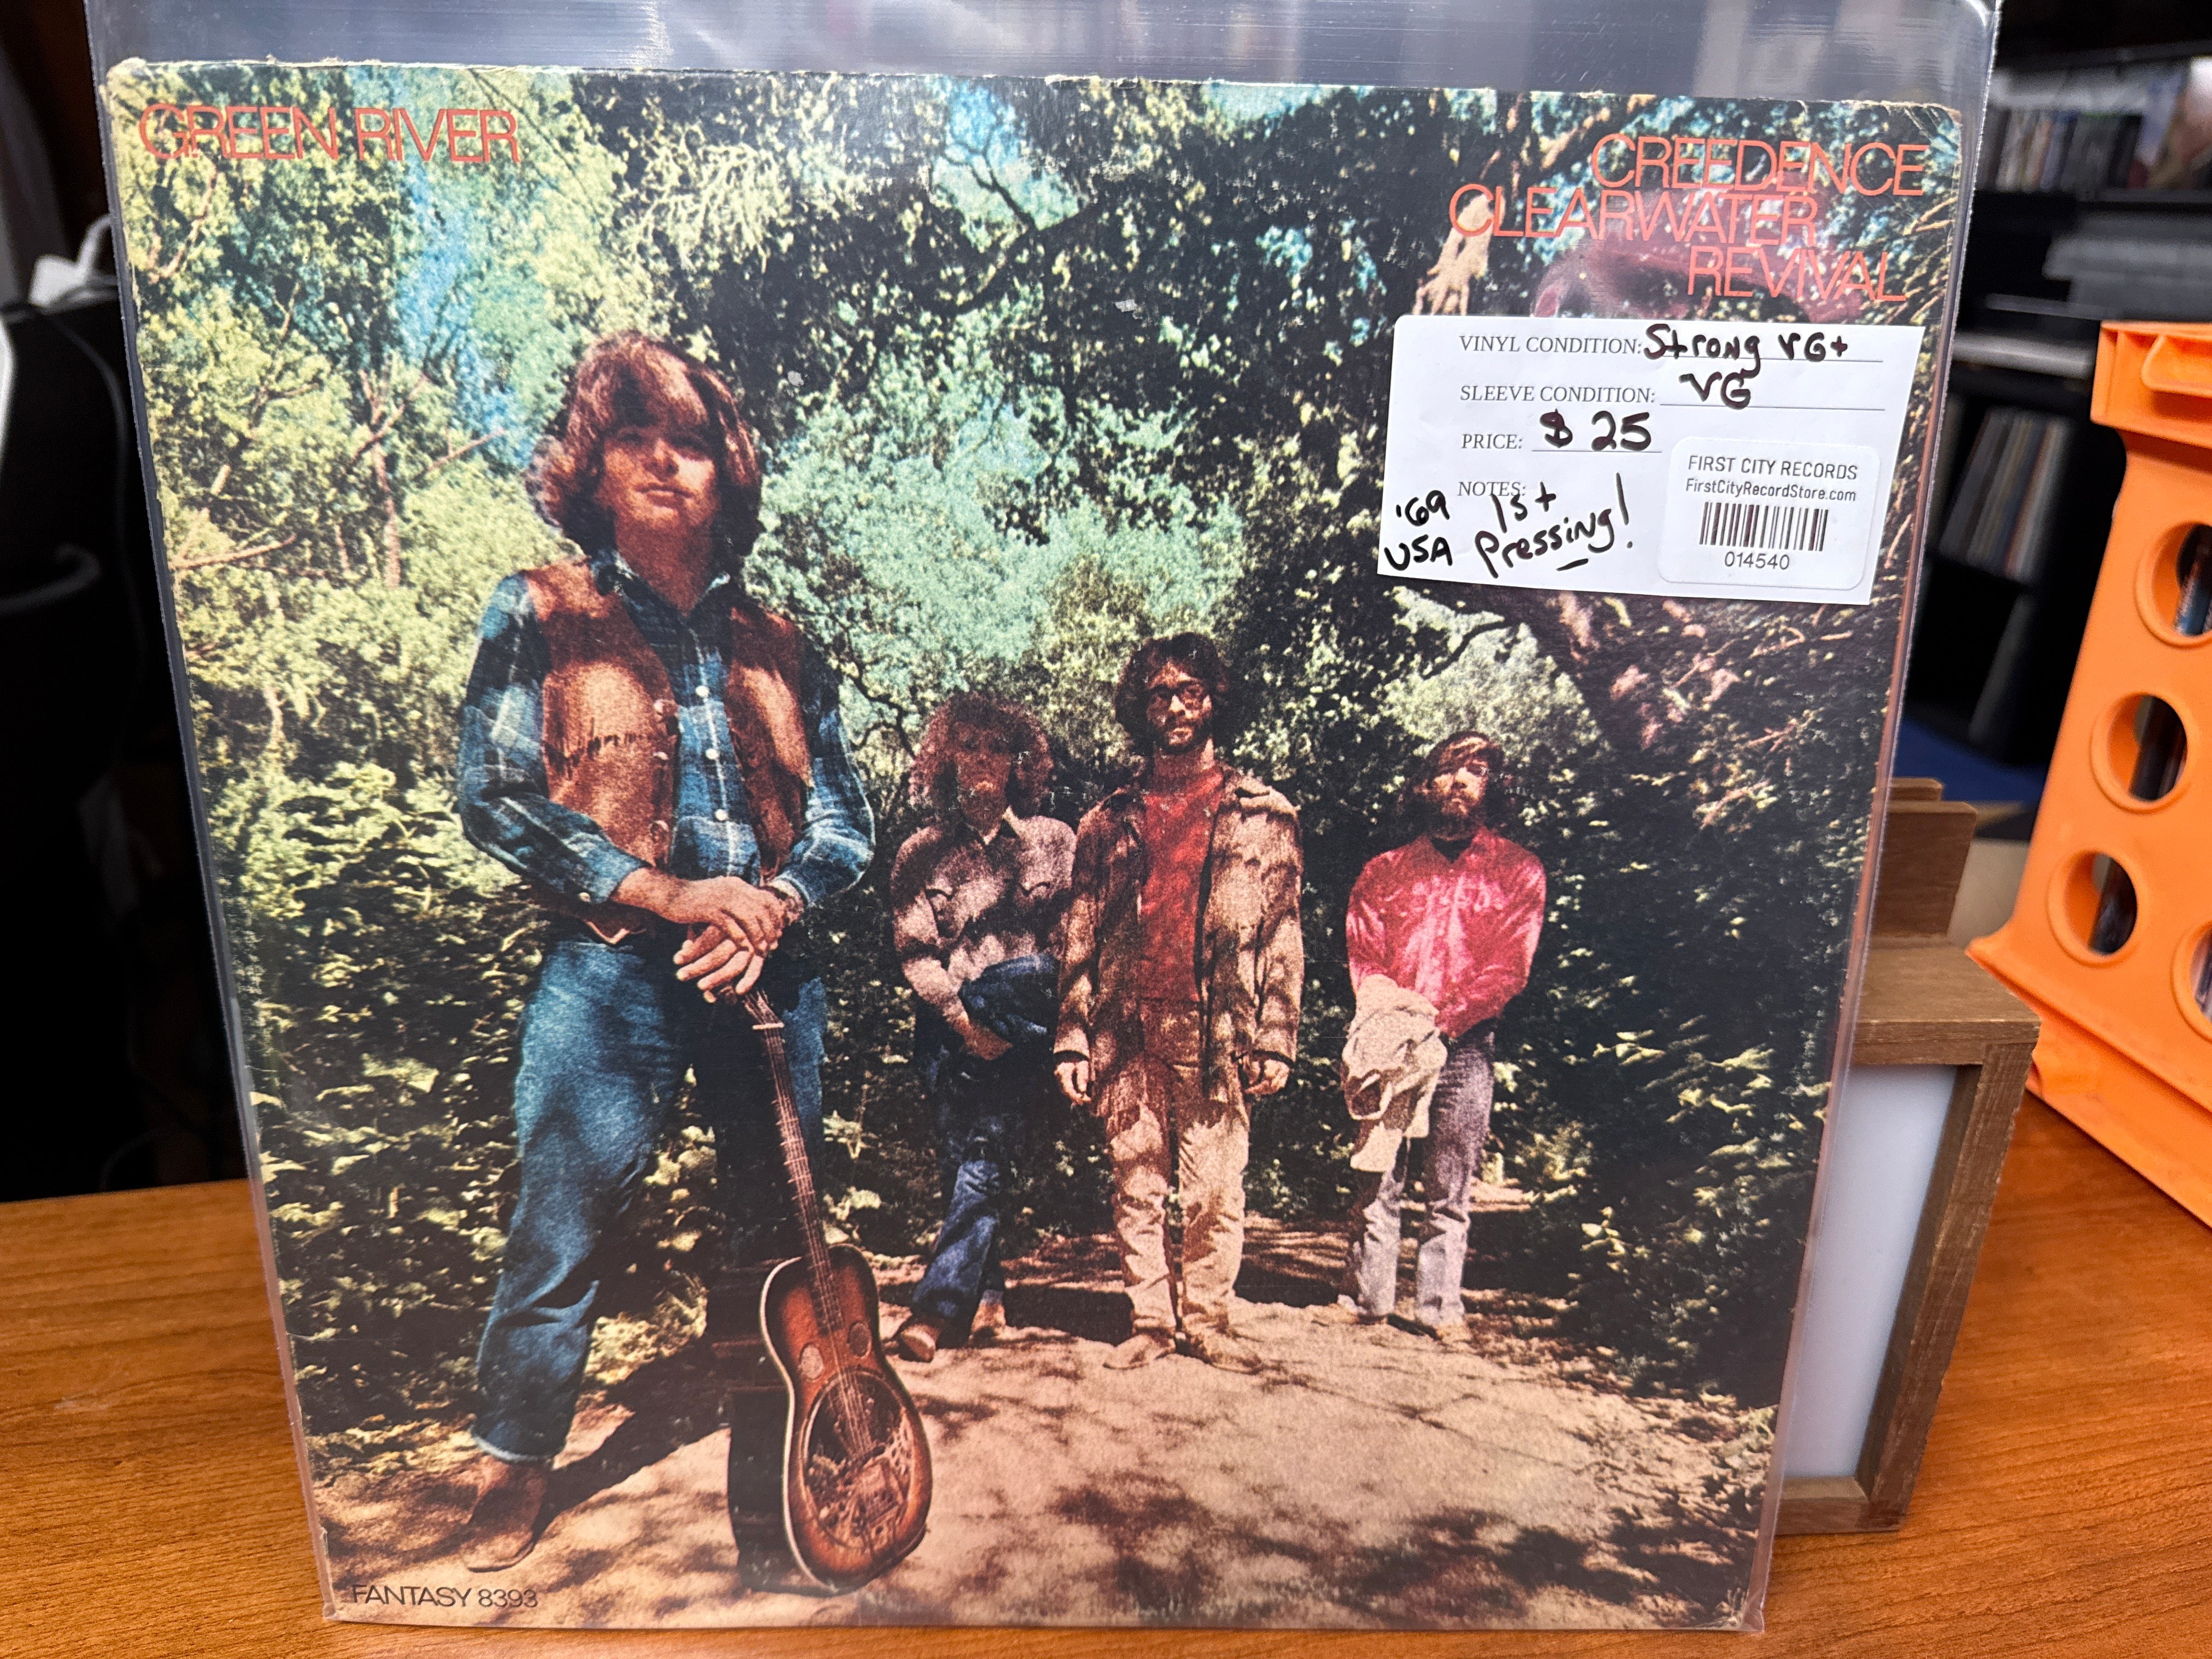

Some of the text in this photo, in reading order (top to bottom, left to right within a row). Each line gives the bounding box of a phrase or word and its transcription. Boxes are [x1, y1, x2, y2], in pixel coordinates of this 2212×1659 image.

[138, 104, 521, 162] GREEN RIVER
[1590, 133, 1928, 197] CREEDENCE
[1449, 183, 1819, 246] CLEARWATER
[1686, 245, 1908, 302] REVIVAL
[1460, 335, 1643, 354] VINYL CONDITION:
[1644, 323, 1848, 379] Strong VG+
[1460, 385, 1656, 404] SLEEVE CONDITION:
[1679, 372, 1752, 409] VG
[1461, 433, 1523, 450] PRICE:
[1539, 409, 1651, 452] $ 25
[1688, 455, 1858, 479] FIRST CITY RECORDS
[1457, 481, 1526, 498] NOTES:
[1685, 479, 1857, 502] FirstCityRecordStore.com
[1384, 534, 1454, 571] USA
[1724, 551, 1791, 571] 014540
[352, 1584, 538, 1608] FANTASY 8393
